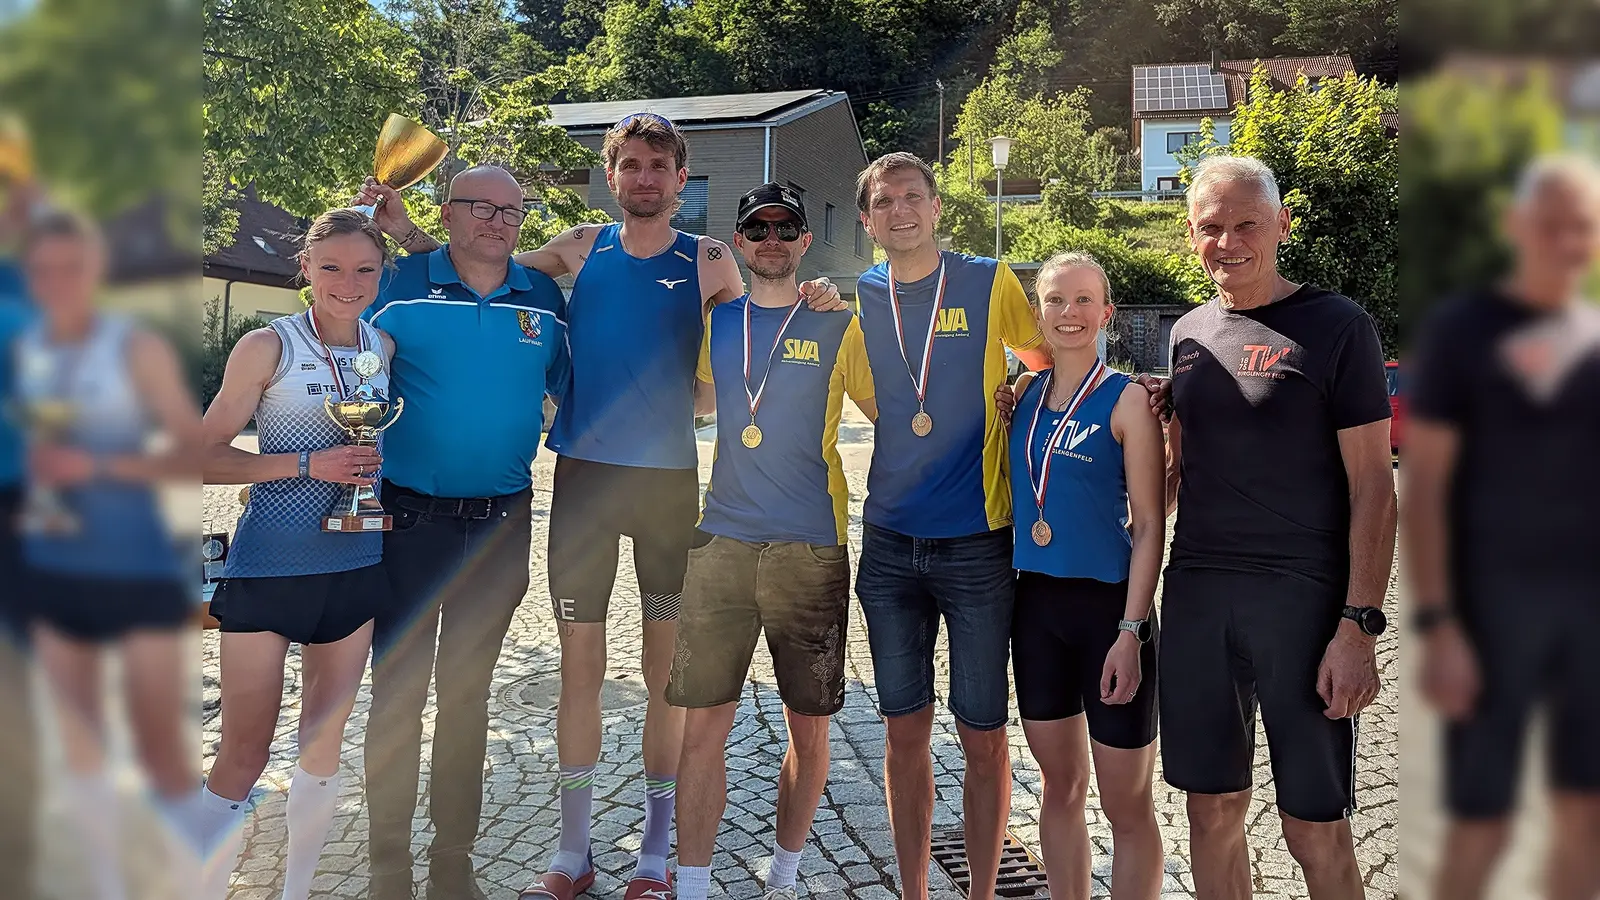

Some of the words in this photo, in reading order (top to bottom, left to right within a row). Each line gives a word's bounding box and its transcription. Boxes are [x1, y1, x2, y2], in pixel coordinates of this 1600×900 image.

[783, 338, 820, 362] SVA
[323, 384, 350, 393] TES
[1042, 447, 1093, 462] GLENGENFELD
